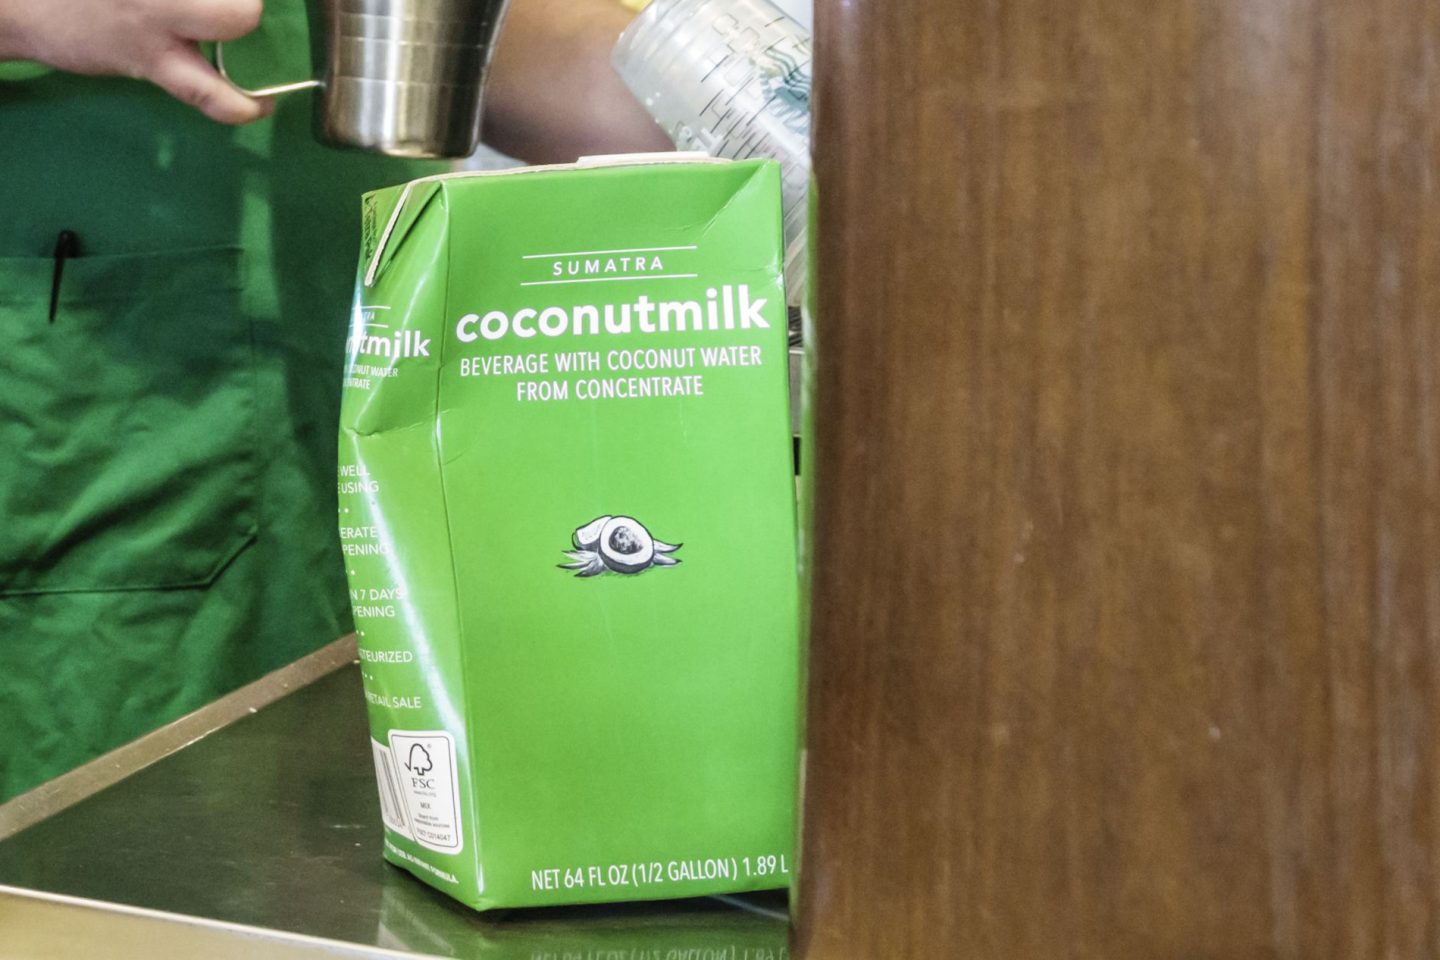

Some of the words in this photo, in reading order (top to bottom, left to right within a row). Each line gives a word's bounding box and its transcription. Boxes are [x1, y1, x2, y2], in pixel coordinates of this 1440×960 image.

[552, 256, 664, 276] SUMATRA
[456, 284, 770, 343] coconutmilk
[460, 353, 548, 377] BEVERAGE
[554, 351, 600, 372] WITH
[607, 348, 696, 371] COCONUT
[700, 345, 762, 368] WATER
[517, 381, 569, 401] FROM
[575, 375, 705, 400] CONCENTRATE
[340, 526, 379, 539] ERATE
[342, 543, 390, 556] PENING
[392, 696, 422, 709] SALE
[411, 777, 436, 790] FSC
[531, 869, 560, 890] NET
[564, 867, 585, 888] 64
[589, 866, 606, 886] FL
[608, 864, 629, 885] OZ
[632, 862, 663, 887] (1/2
[742, 855, 777, 877] 1.89
[780, 854, 789, 874] L
